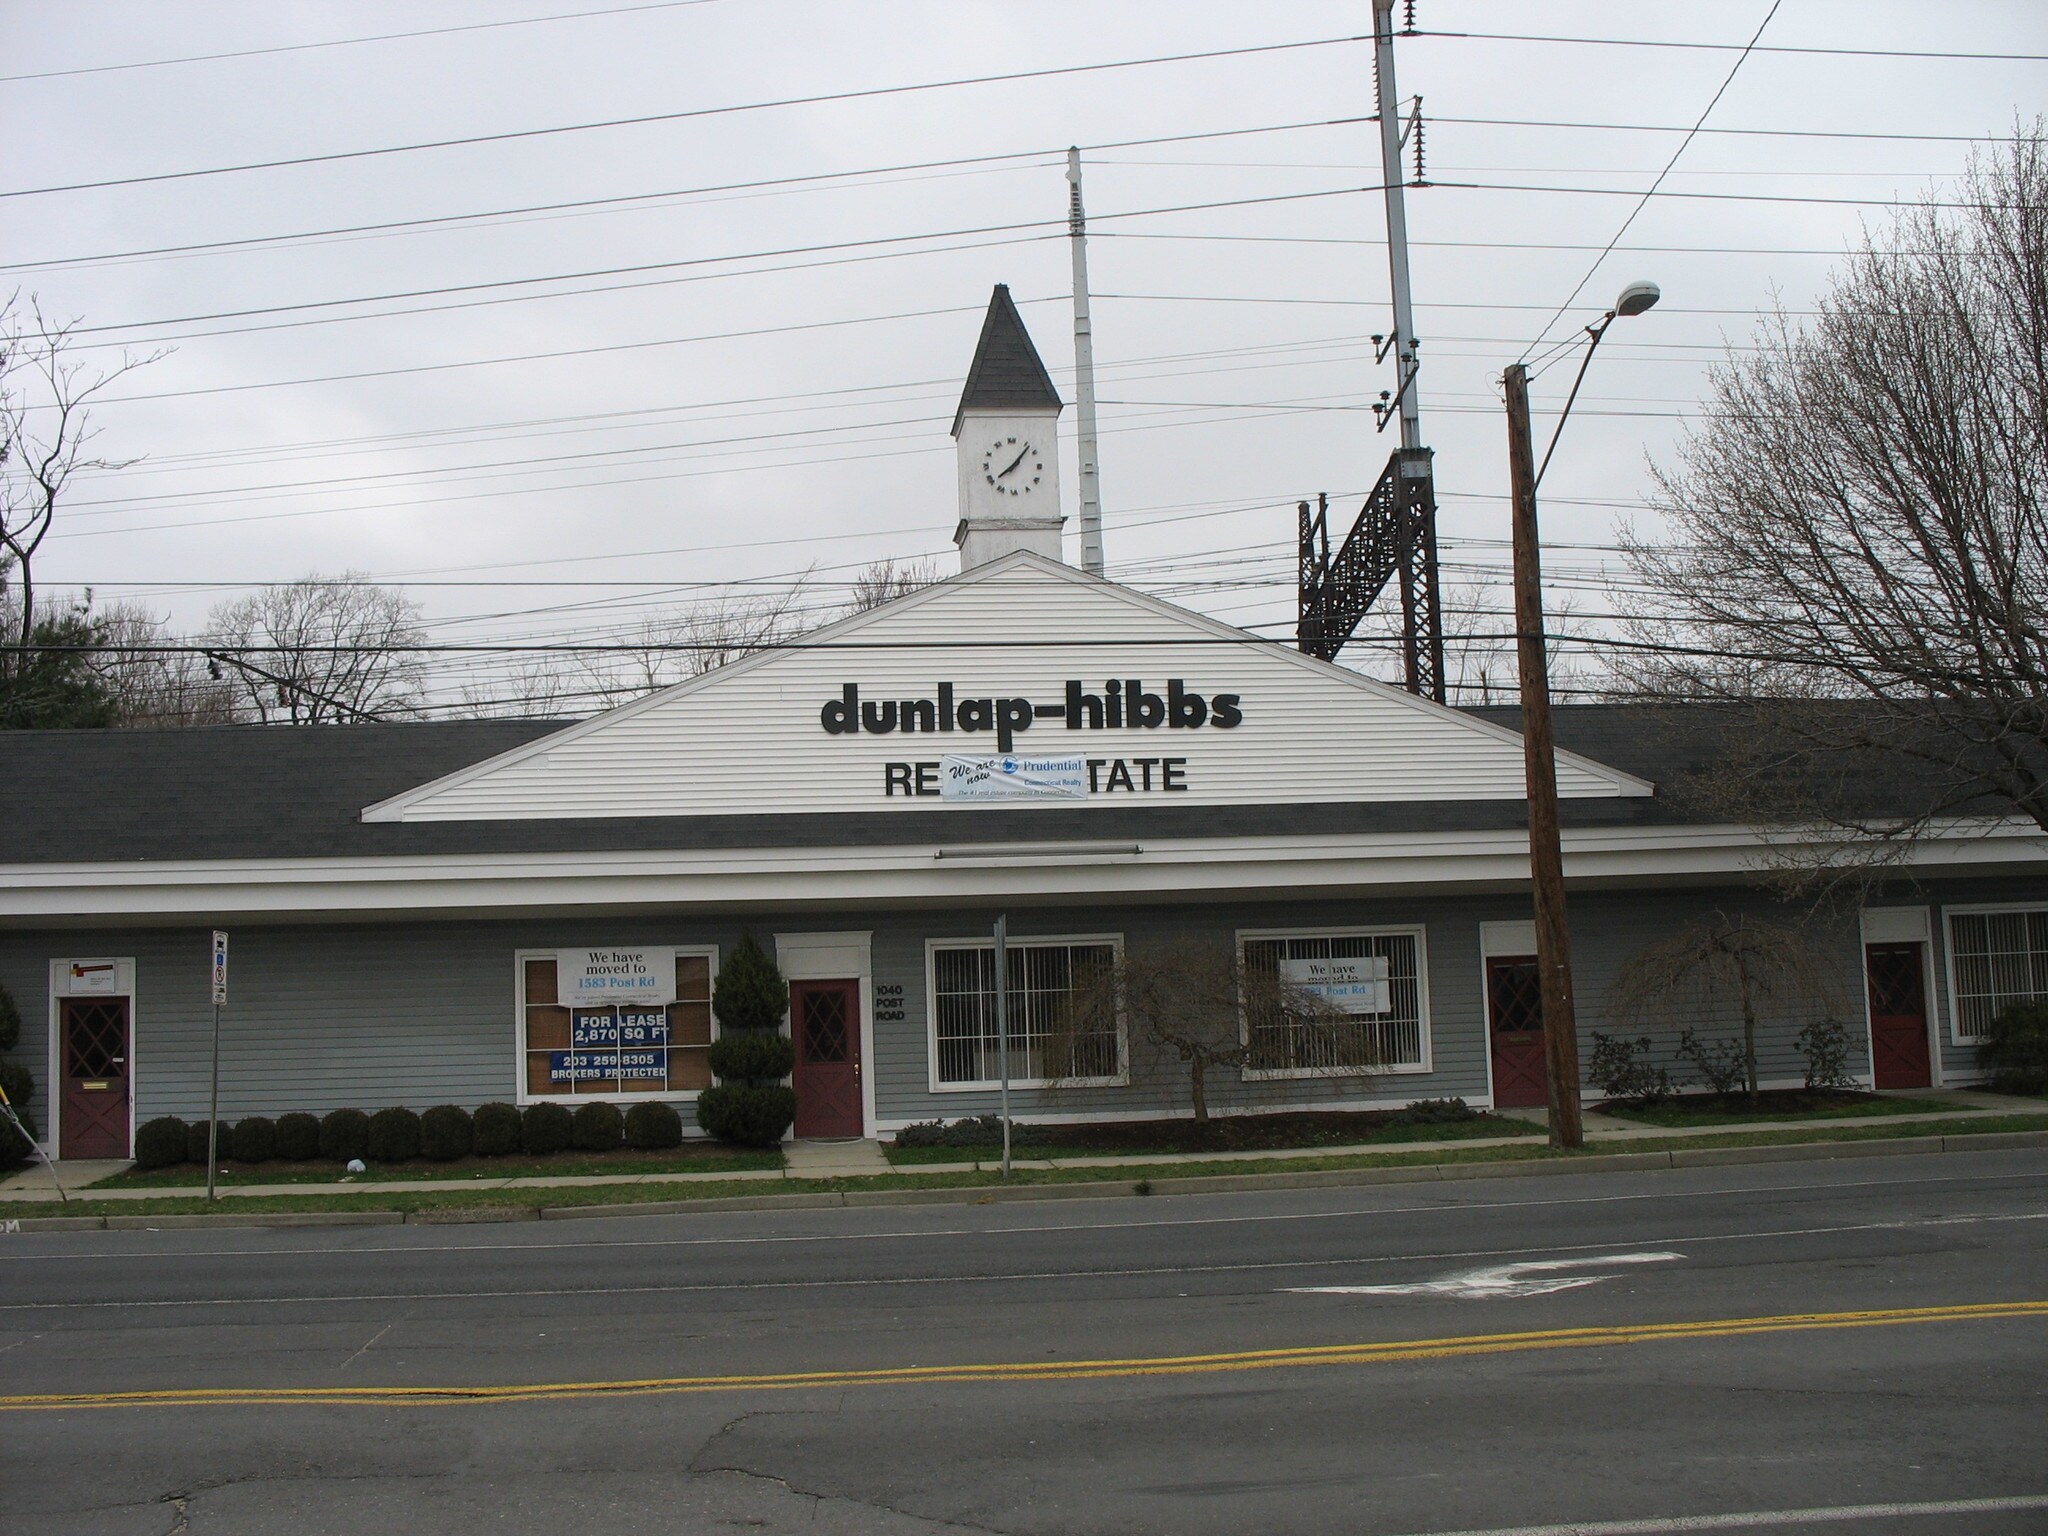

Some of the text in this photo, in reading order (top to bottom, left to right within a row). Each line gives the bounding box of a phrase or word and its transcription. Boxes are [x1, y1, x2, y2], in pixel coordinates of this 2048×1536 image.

[821, 679, 1242, 753] dunlap-hibbs
[949, 760, 996, 779] We are
[1023, 761, 1082, 771] Prudential
[885, 757, 1188, 796] RE TATE
[966, 771, 990, 785] now
[1062, 779, 1081, 787] Realty
[589, 952, 643, 963] We have
[586, 963, 646, 975] moved to
[1309, 965, 1326, 975] We
[578, 976, 656, 989] 1583 Post Rd
[876, 985, 902, 995] 1040
[1326, 986, 1347, 996] Post
[1352, 985, 1366, 994] Rd
[876, 998, 904, 1008] POST
[580, 1014, 665, 1028] FOR LEASE
[876, 1011, 905, 1021] ROAD
[575, 1029, 617, 1043] 2,870
[624, 1028, 645, 1039] SQ
[563, 1056, 587, 1067] 203
[551, 1068, 667, 1079] BROKERS PROTECTED
